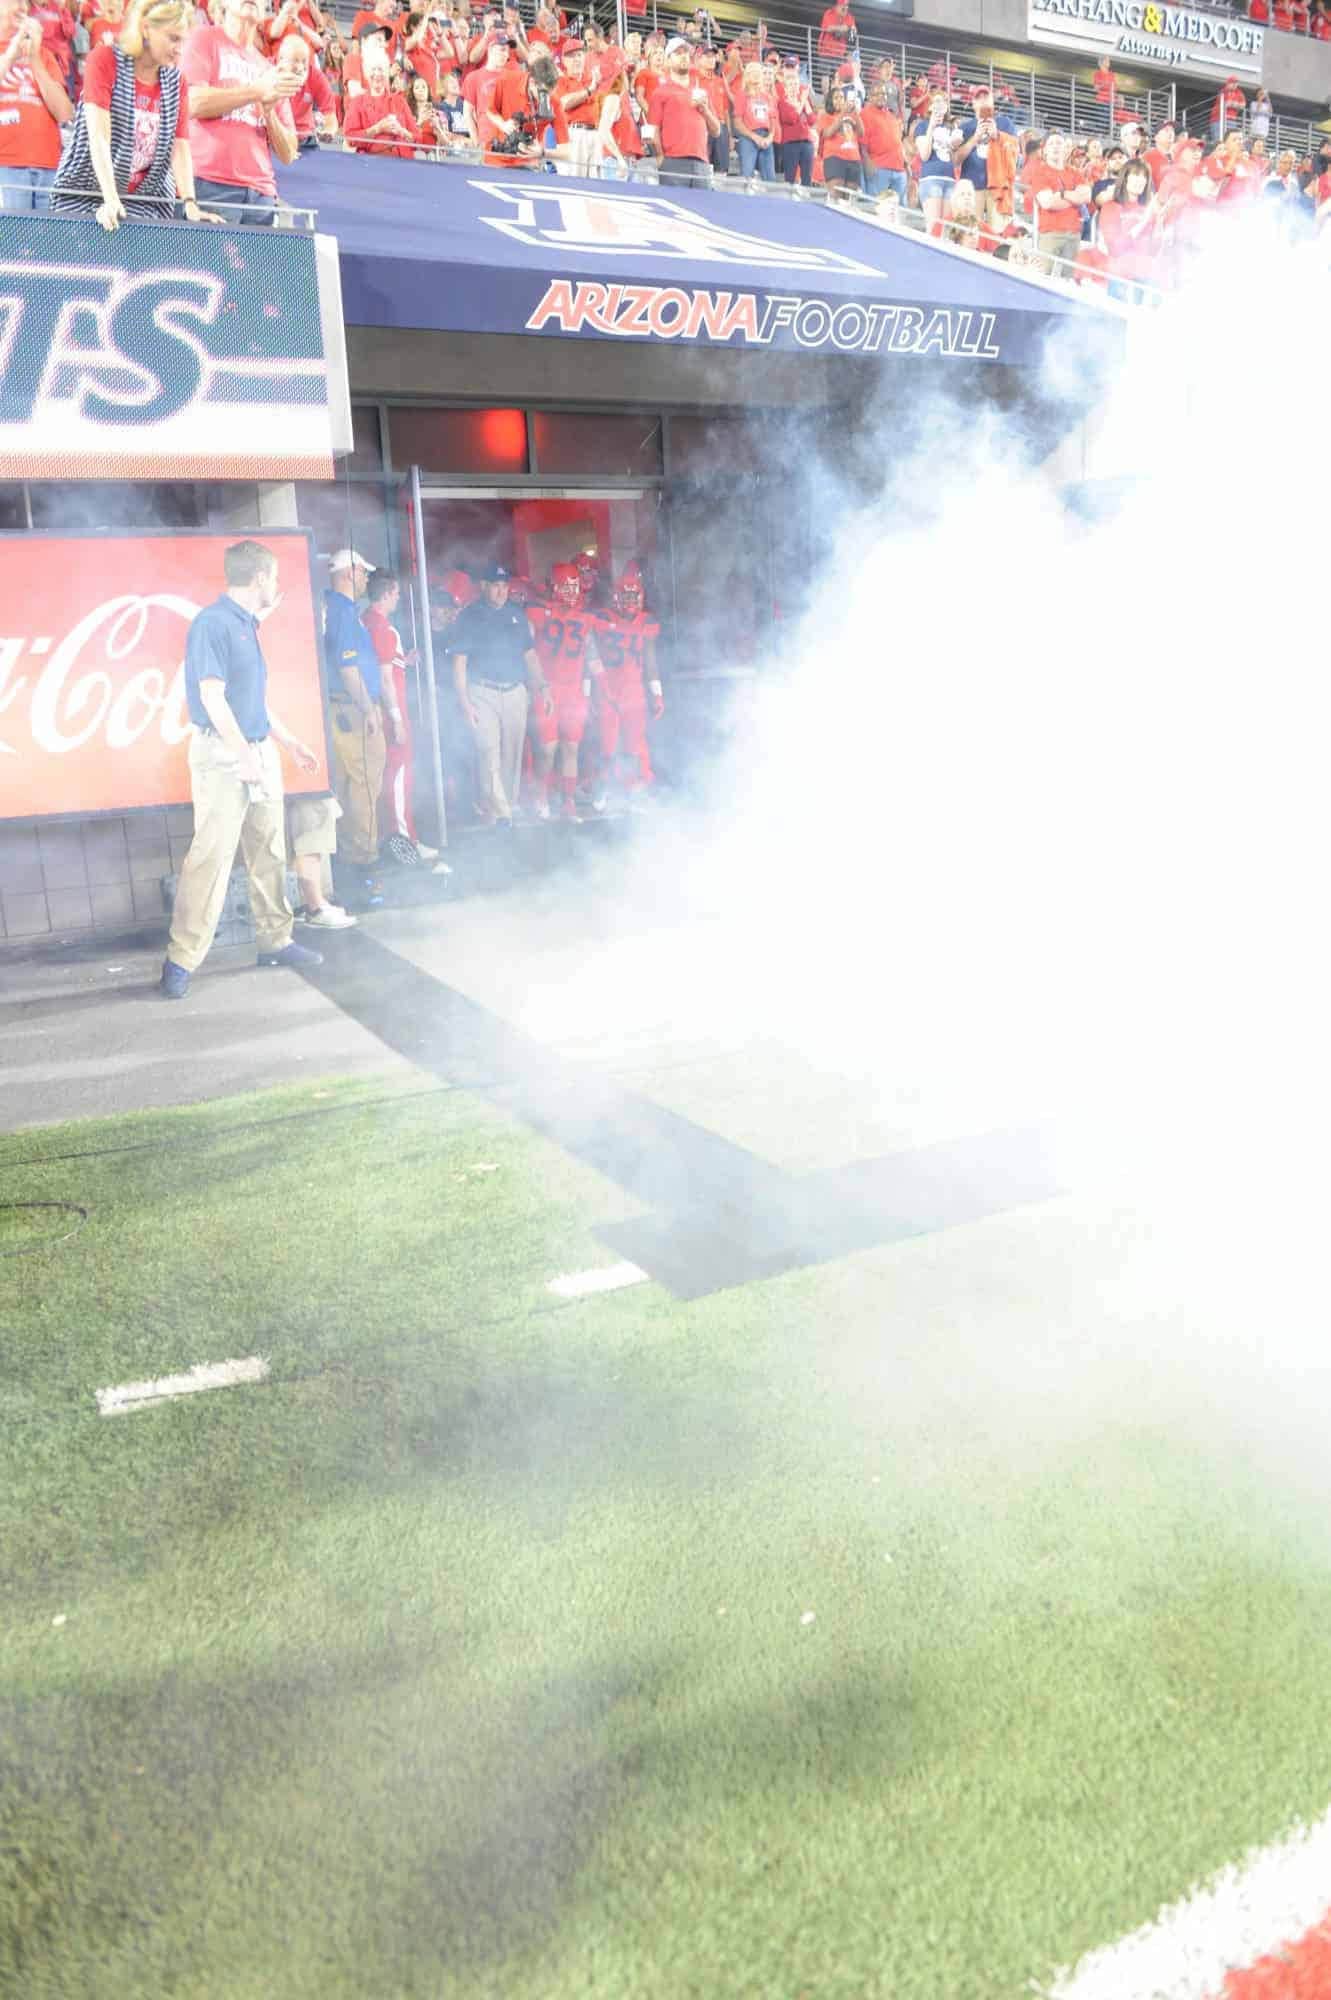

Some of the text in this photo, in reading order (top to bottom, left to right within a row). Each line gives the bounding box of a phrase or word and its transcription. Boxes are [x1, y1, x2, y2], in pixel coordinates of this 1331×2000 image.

[1119, 33, 1187, 65] Attorneys
[525, 278, 1000, 359] ARIZONA FOOTBALL
[543, 618, 587, 660] 93
